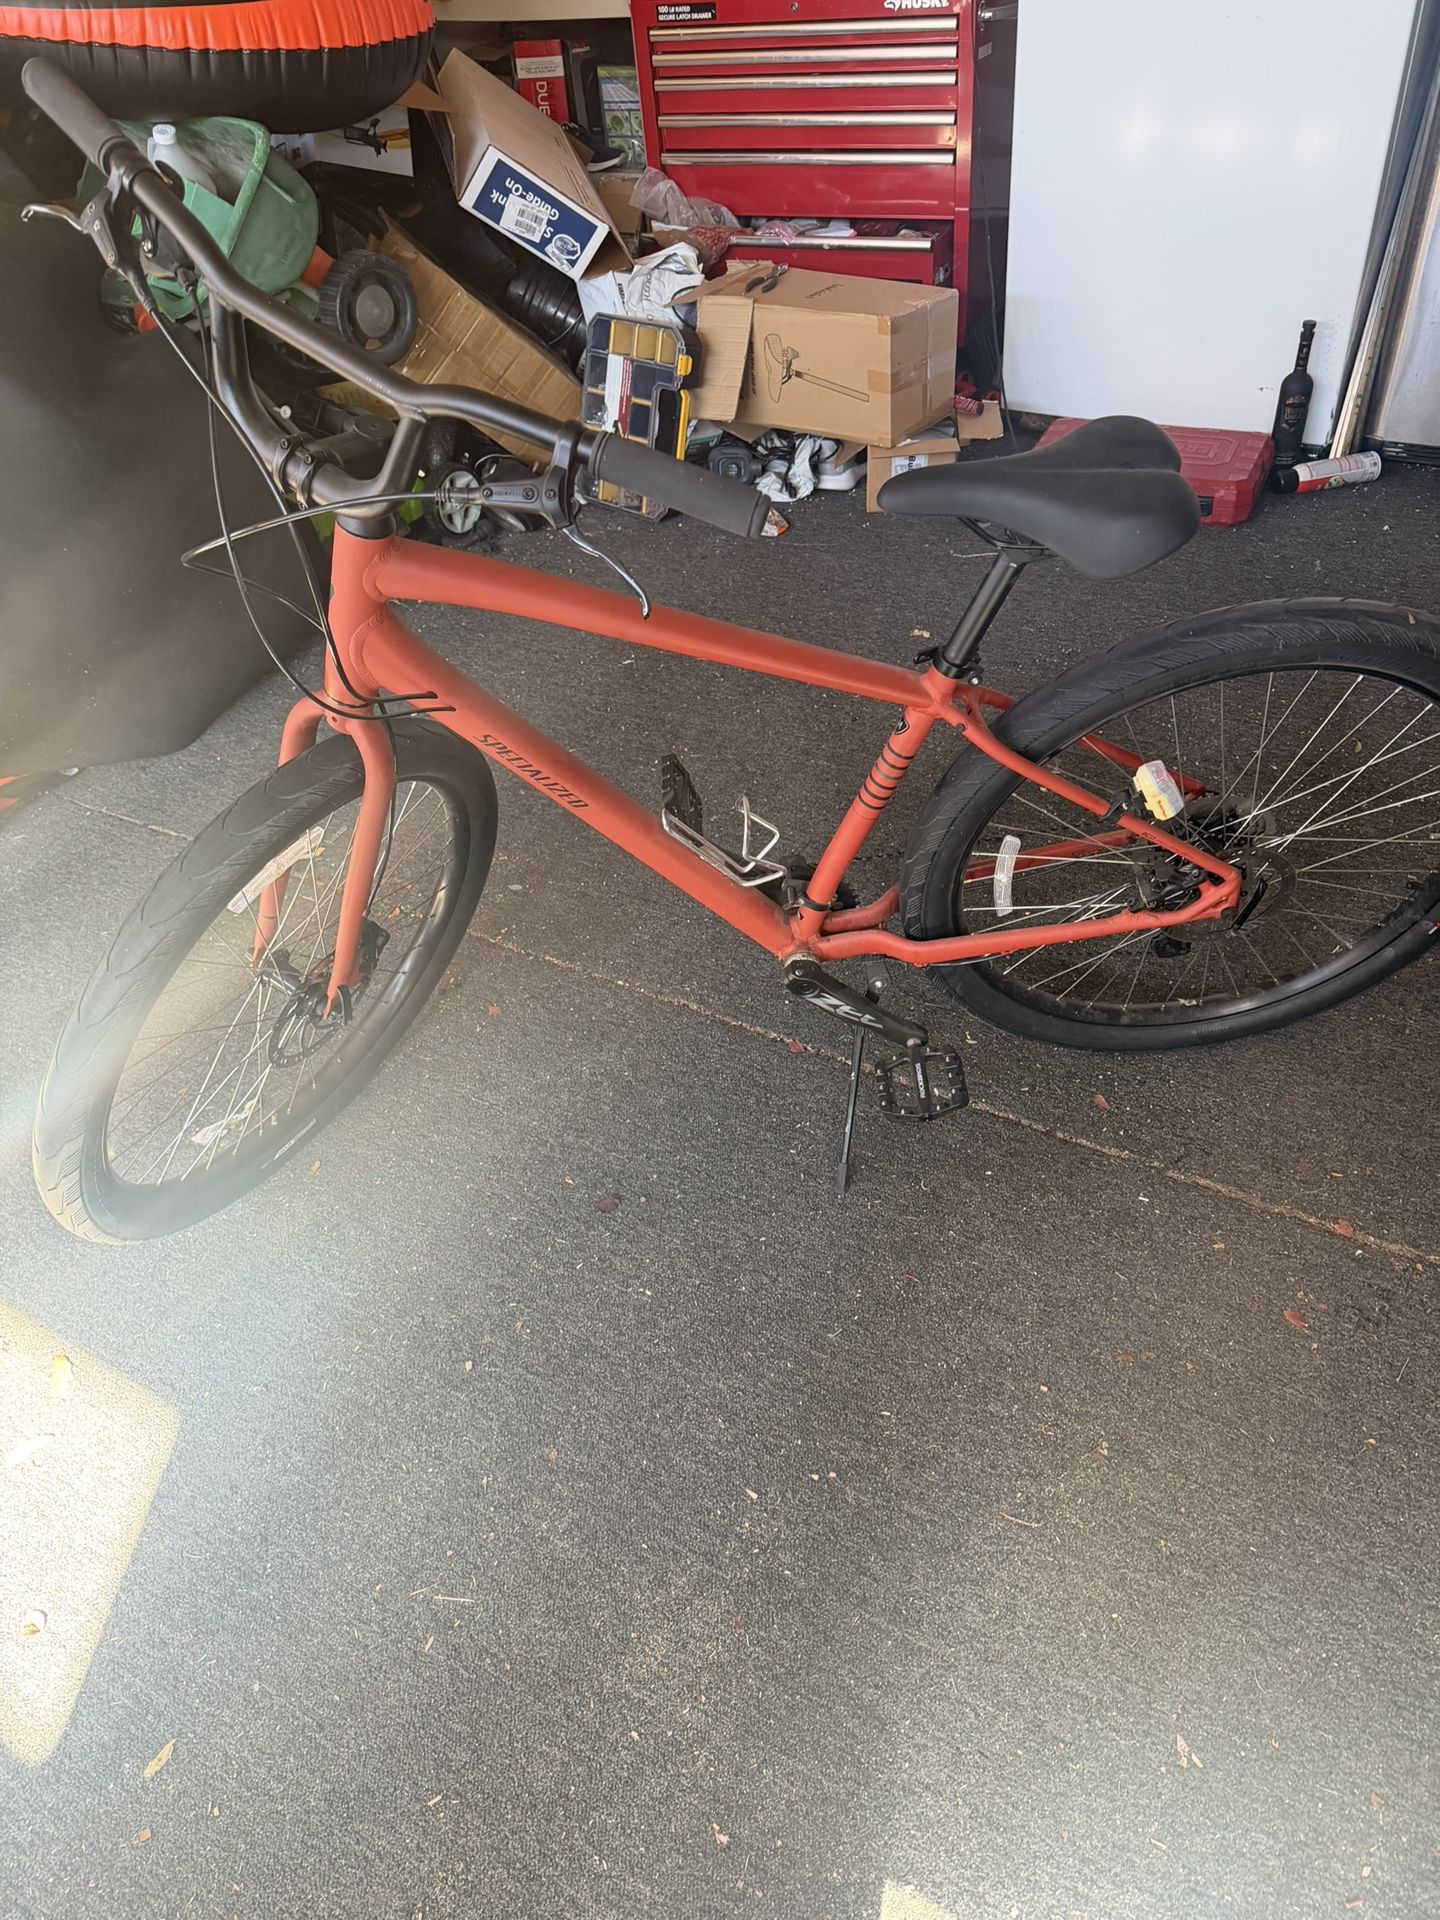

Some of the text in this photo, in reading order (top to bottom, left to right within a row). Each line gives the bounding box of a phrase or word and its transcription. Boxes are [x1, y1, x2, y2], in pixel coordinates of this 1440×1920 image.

[657, 5, 668, 13] 100
[691, 12, 712, 20] DRAWER
[473, 733, 590, 809] SPECIALIZED
